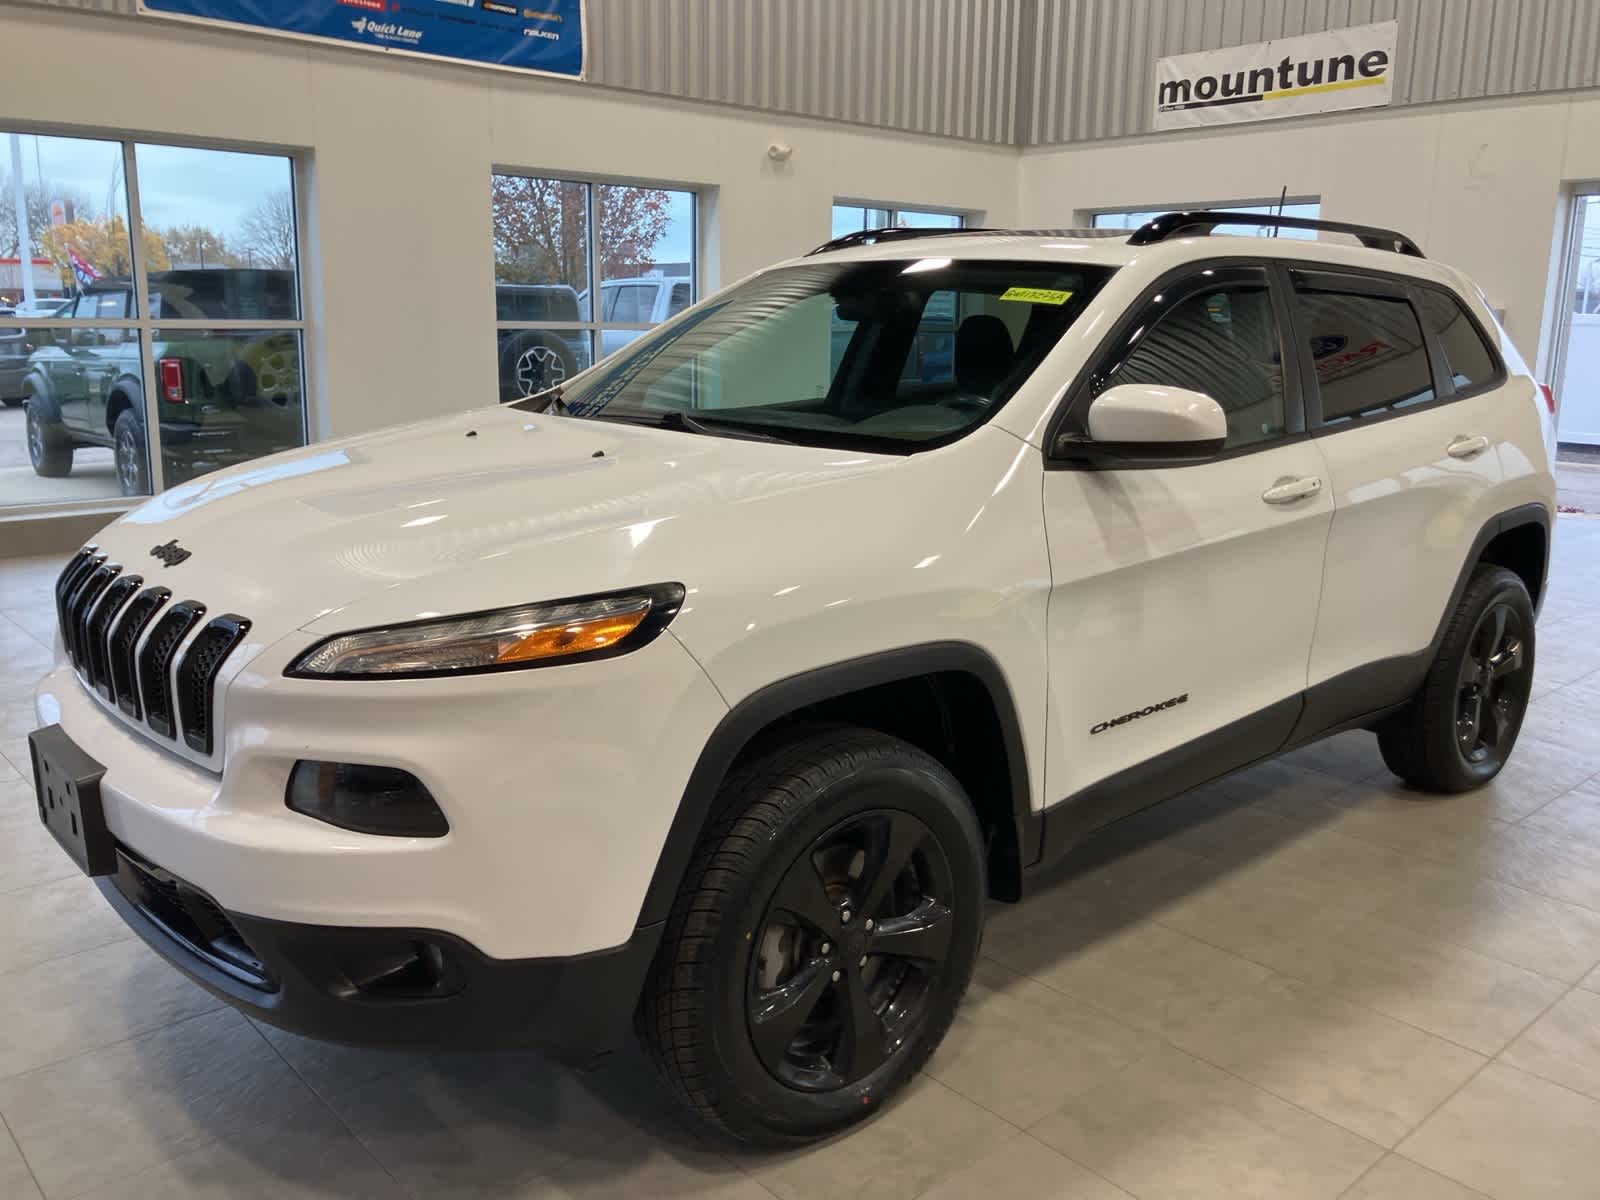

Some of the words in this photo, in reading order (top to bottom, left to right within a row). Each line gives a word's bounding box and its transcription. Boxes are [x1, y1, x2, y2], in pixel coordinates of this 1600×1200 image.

[367, 20, 397, 34] Quick
[397, 26, 424, 39] Lane
[1158, 50, 1389, 105] mountune
[1089, 693, 1189, 735] CHEROKEE
